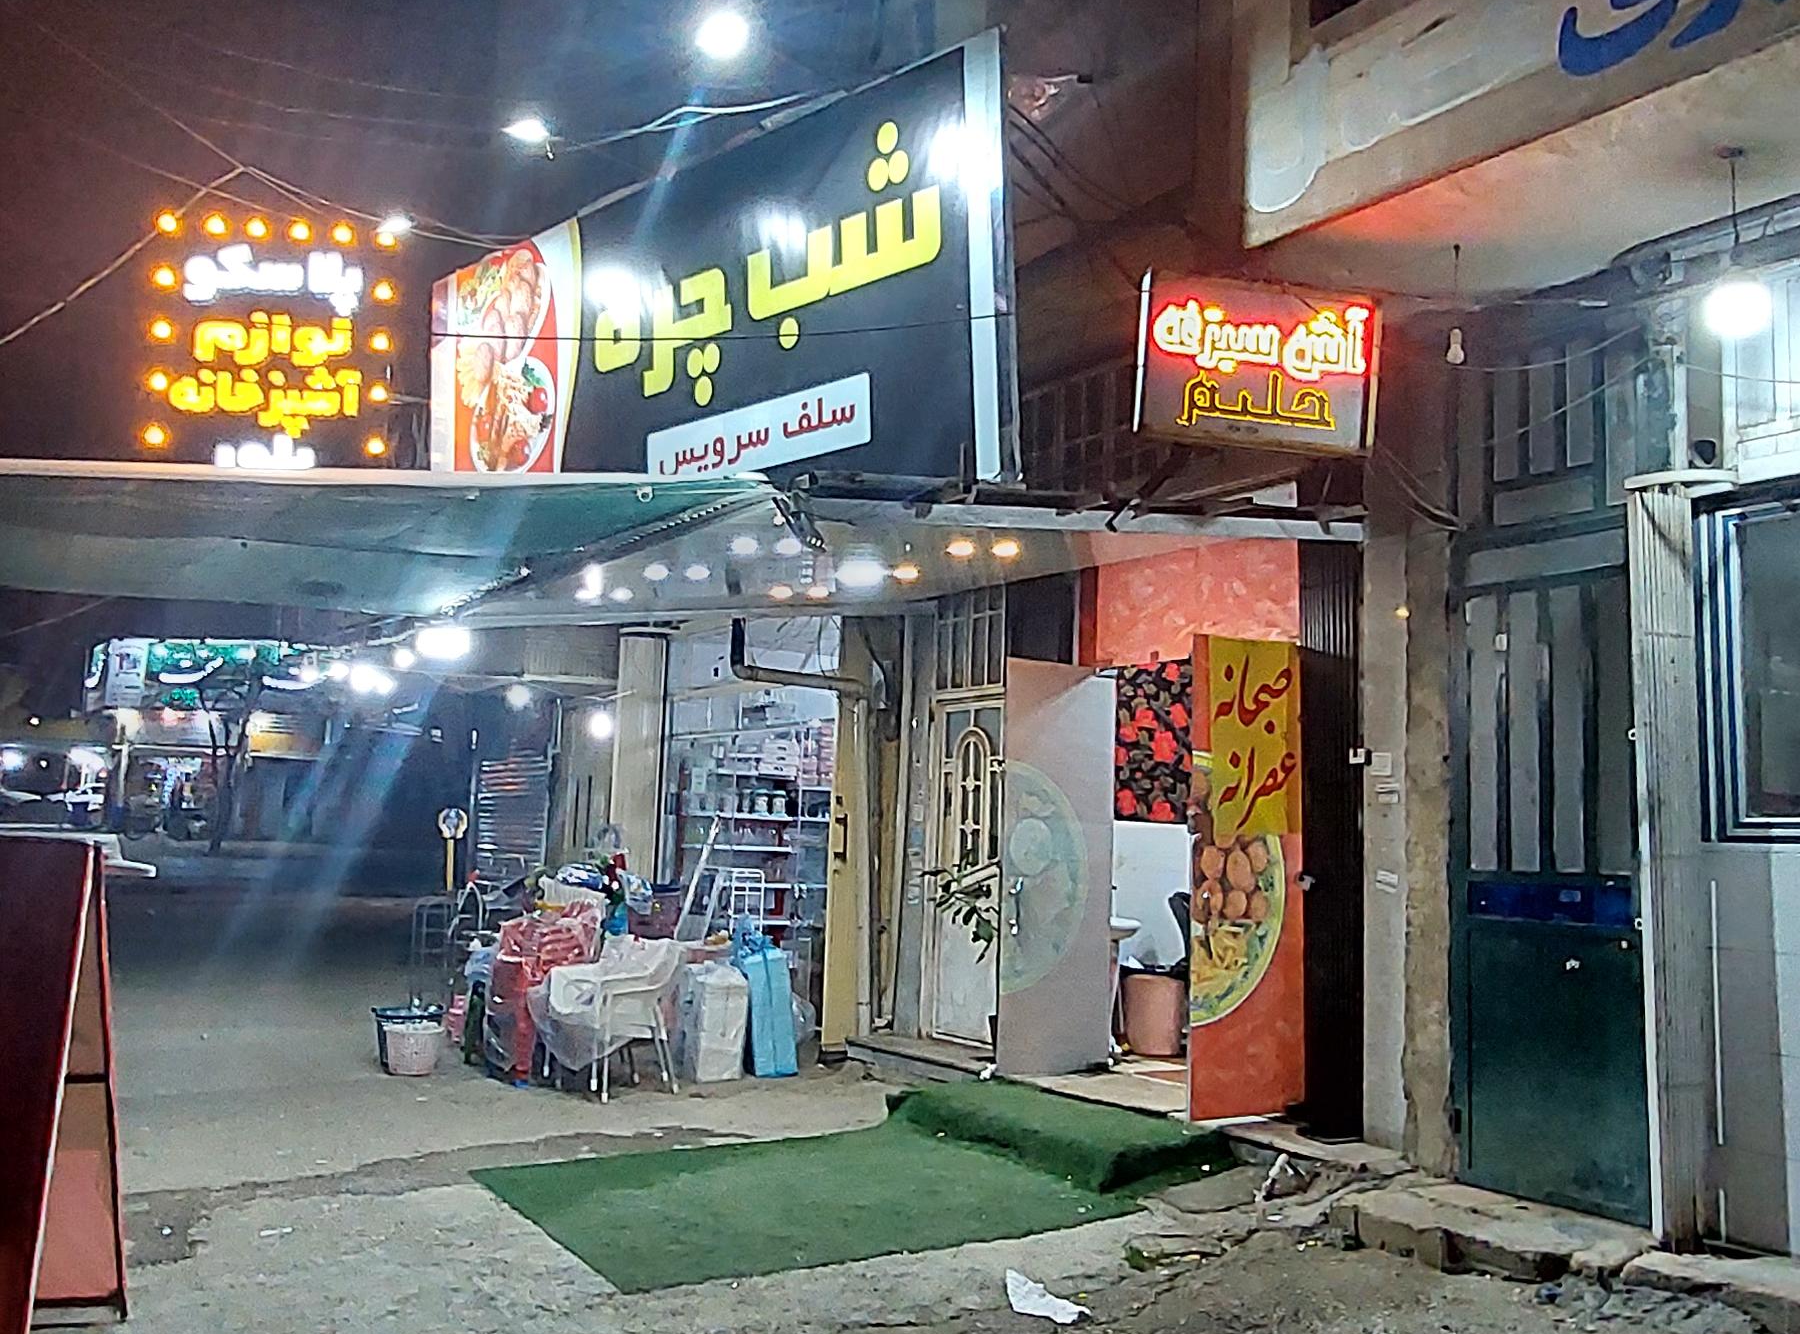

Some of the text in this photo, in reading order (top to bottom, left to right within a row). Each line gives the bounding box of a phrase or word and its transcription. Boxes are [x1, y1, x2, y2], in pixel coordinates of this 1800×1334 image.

[593, 121, 942, 407] شب چره
[193, 311, 353, 367] لوازم
[1283, 305, 1368, 382] آش
[167, 366, 363, 440] آشپزخانه
[658, 396, 857, 476] سلف سرویس
[1176, 370, 1336, 433] حلیم
[1214, 653, 1293, 735] صبحانه
[1217, 746, 1298, 832] عصرانه
